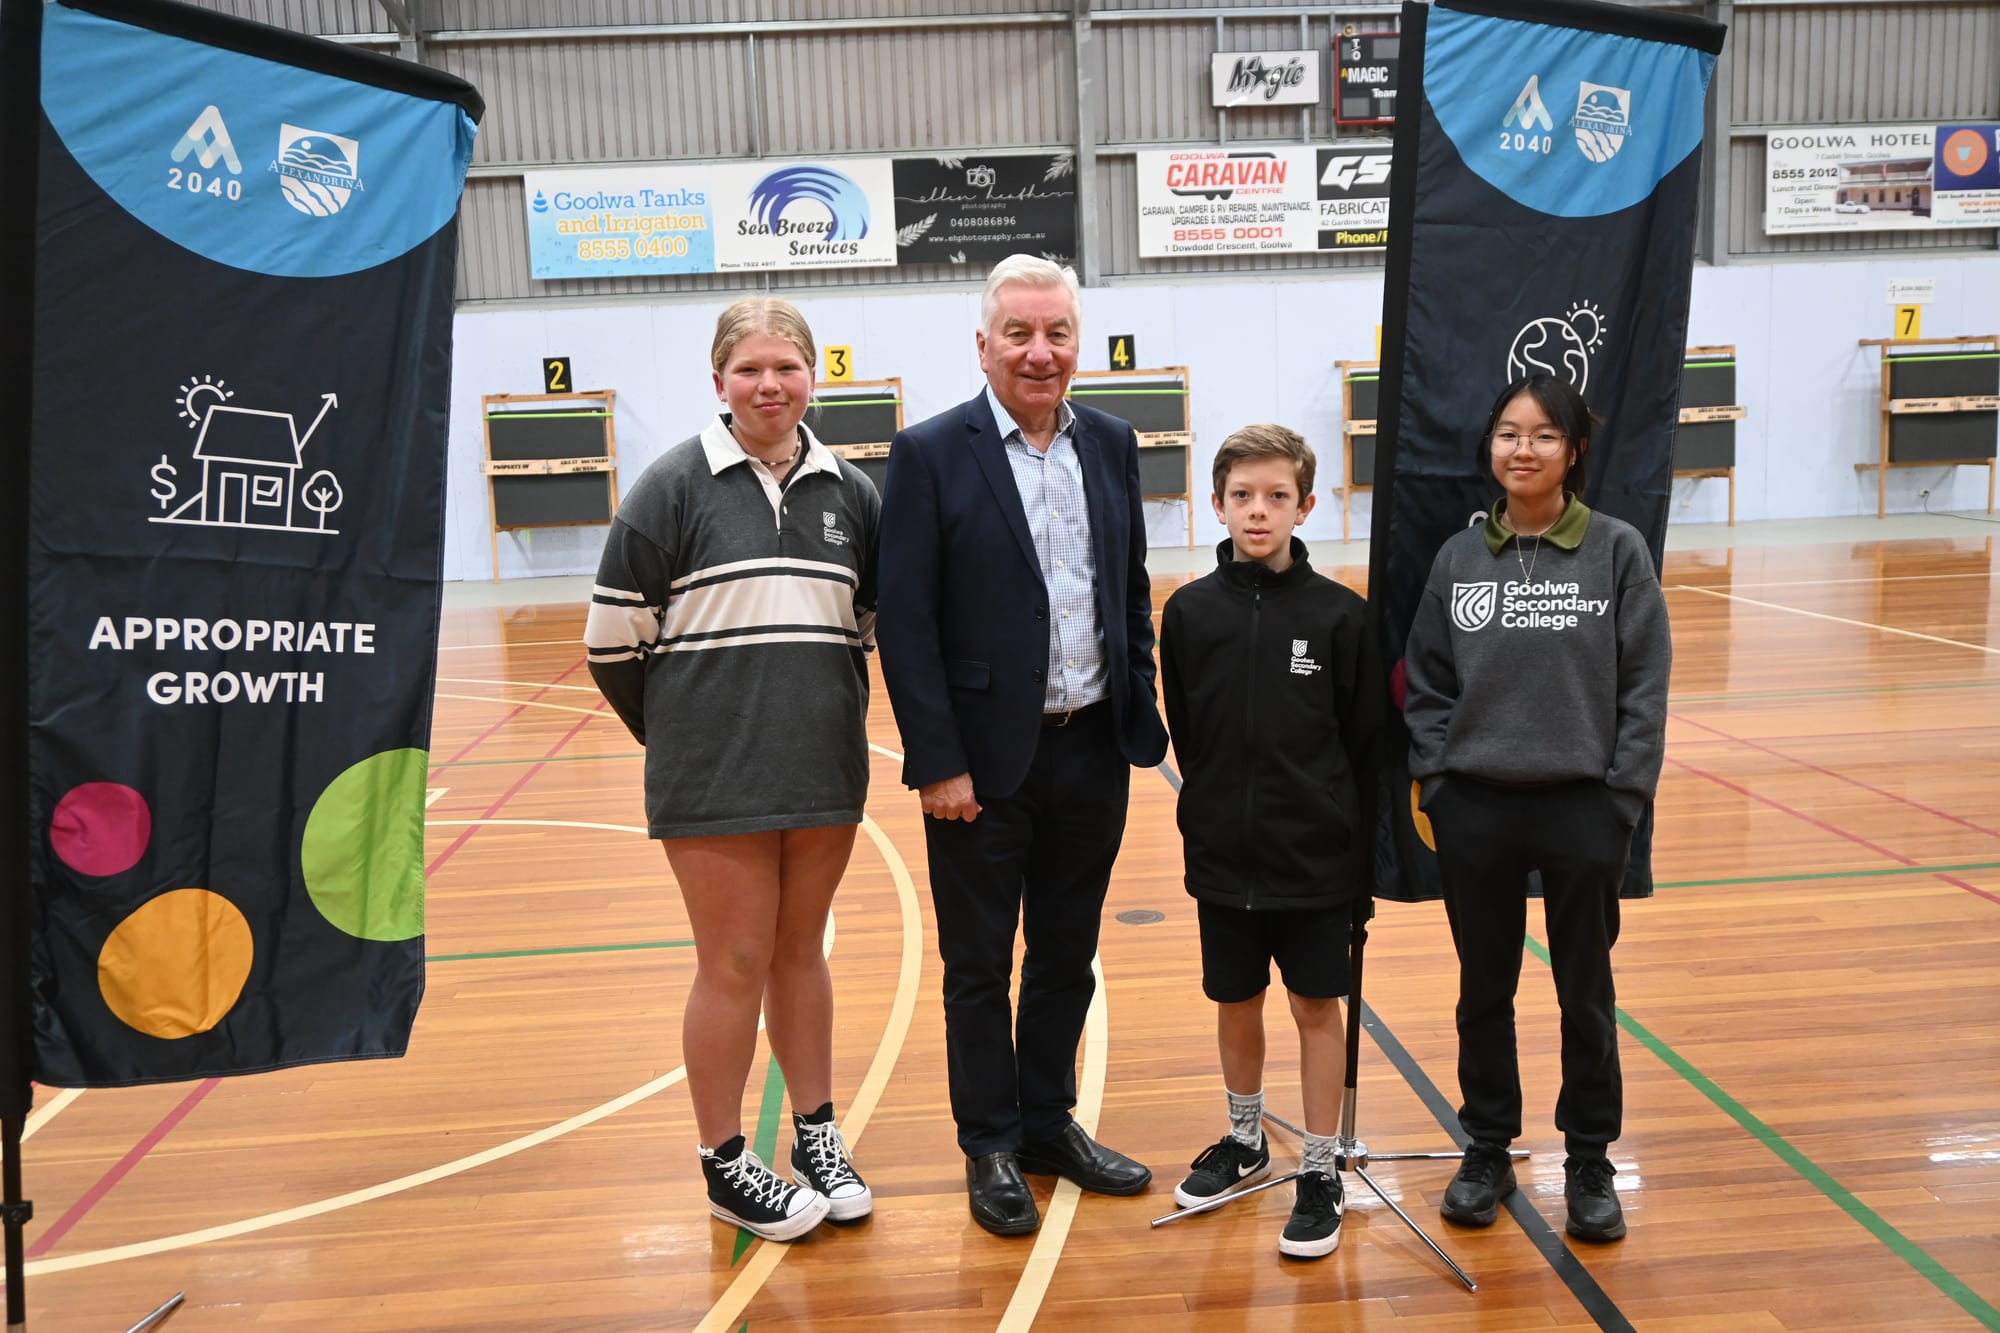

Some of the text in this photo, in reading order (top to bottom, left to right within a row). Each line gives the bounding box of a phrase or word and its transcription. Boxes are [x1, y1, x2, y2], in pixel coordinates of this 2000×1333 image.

[1347, 66, 1389, 83] MAGIC
[1499, 131, 1552, 155] 2040
[1770, 133, 1932, 150] GOOLWA HOTEL
[1169, 152, 1227, 161] GOOLWA
[268, 159, 366, 193] ALEXANDRINA
[1166, 160, 1288, 188] CARAVAN
[1772, 167, 1838, 179] 8555 2012
[167, 167, 242, 201] 2040
[1235, 187, 1283, 195] CENTRE
[1772, 185, 1796, 193] Lunch
[554, 188, 706, 211] Goolwa Tanks
[1179, 204, 1209, 214] CAMPER
[558, 212, 706, 236] and Irrigation
[737, 218, 835, 237] Sea Breeze
[950, 216, 1017, 227] 0408086896
[1171, 215, 1209, 226] UPGRADES
[1218, 214, 1258, 224] INSURANCE
[1260, 213, 1286, 223] CLAIMS
[928, 231, 1046, 243] www.ehphotography.com.au
[1174, 227, 1283, 241] 8555 0001
[578, 236, 688, 260] 8555 0400
[788, 239, 860, 256] Services
[1260, 241, 1293, 249] Goolwa
[1901, 308, 1916, 335] 7
[1112, 337, 1130, 367] 4
[830, 349, 846, 377] 3
[548, 360, 567, 390] 2
[823, 526, 844, 535] Goolwa
[823, 531, 850, 543] Secondary
[824, 536, 843, 546] College
[1503, 580, 1580, 596] Goolwa
[1502, 595, 1610, 616] Secondary
[1501, 612, 1579, 631] College
[88, 616, 377, 654] APPROPRIATE
[1290, 656, 1315, 664] Goolwa
[1290, 661, 1322, 671] Secondary
[1290, 667, 1313, 676] College
[146, 670, 325, 705] GROWTH
